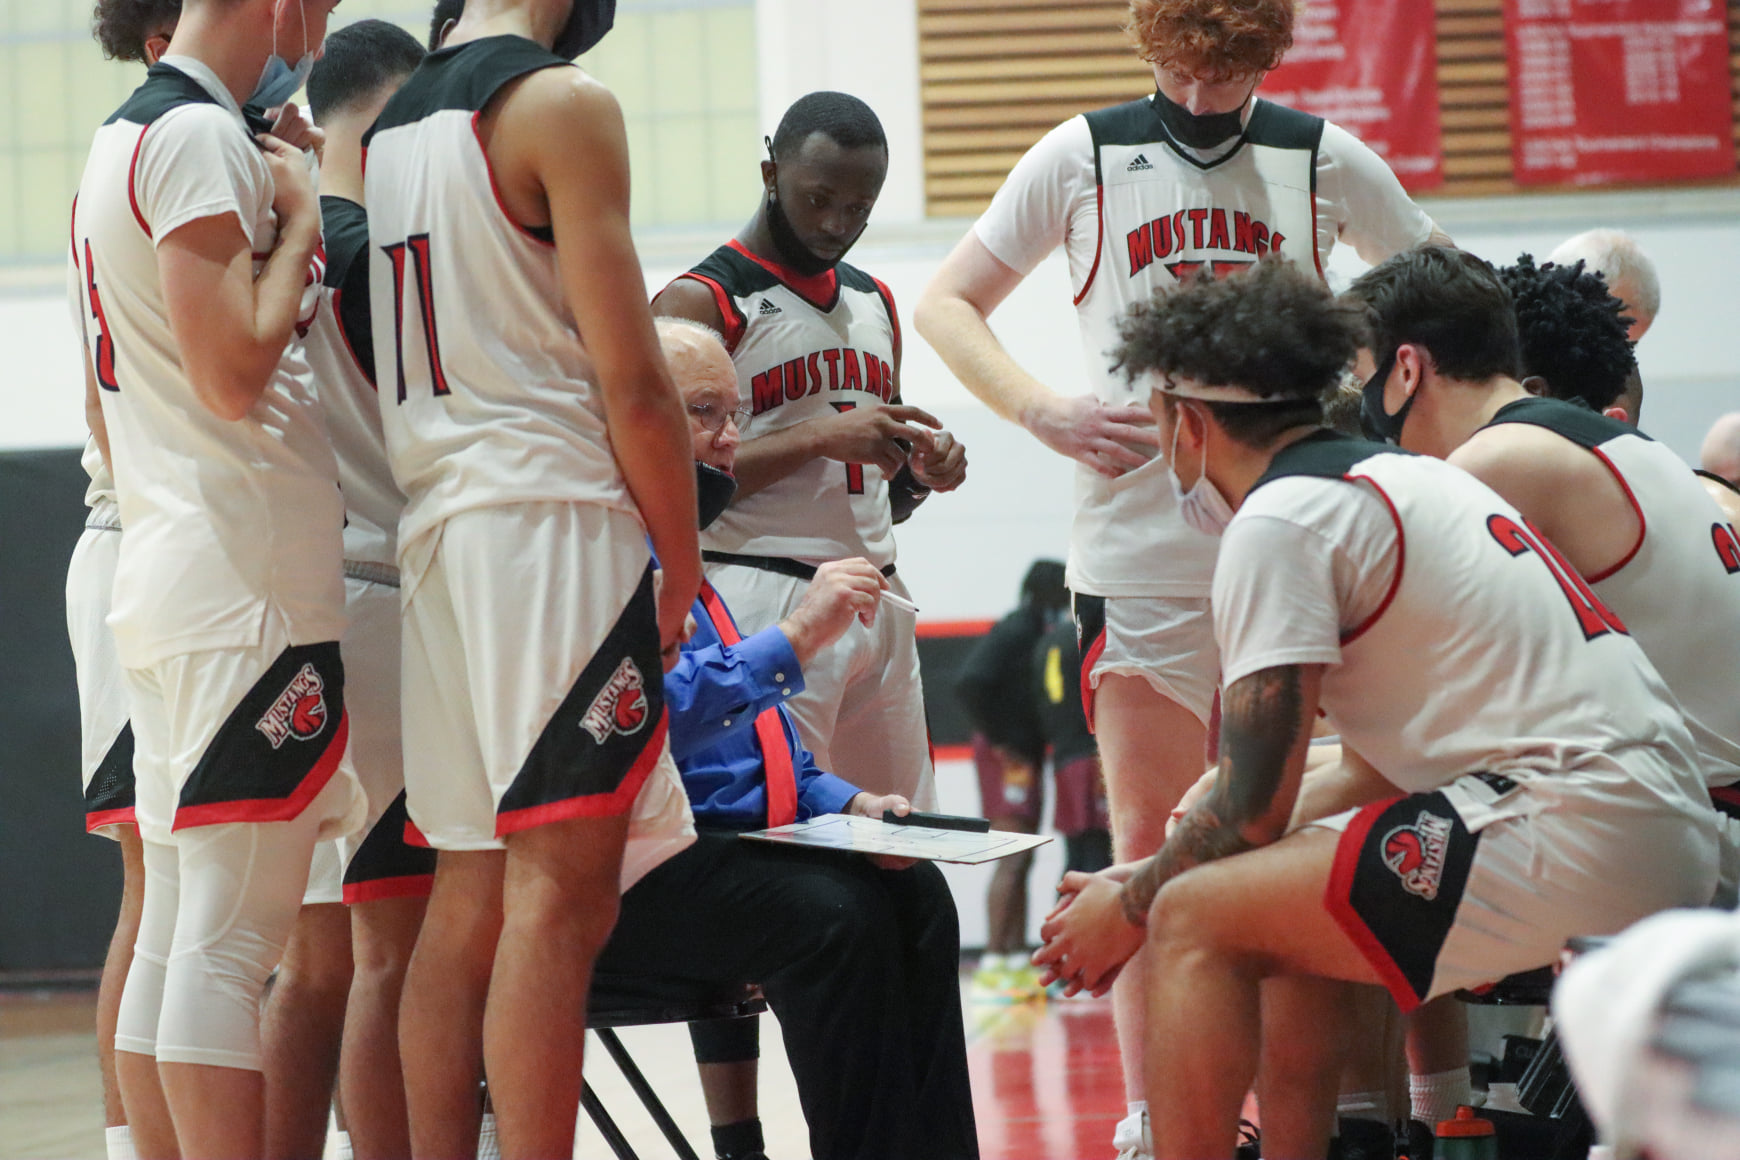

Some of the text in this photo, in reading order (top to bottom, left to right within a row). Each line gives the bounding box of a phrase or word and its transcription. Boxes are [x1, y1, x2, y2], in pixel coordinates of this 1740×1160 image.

[1126, 162, 1154, 172] adidas
[381, 232, 452, 406] 11
[759, 307, 783, 315] adidas
[751, 347, 893, 417] MUSTANG
[256, 664, 323, 748] MUSTANGS
[580, 657, 643, 744] MUSTANGS
